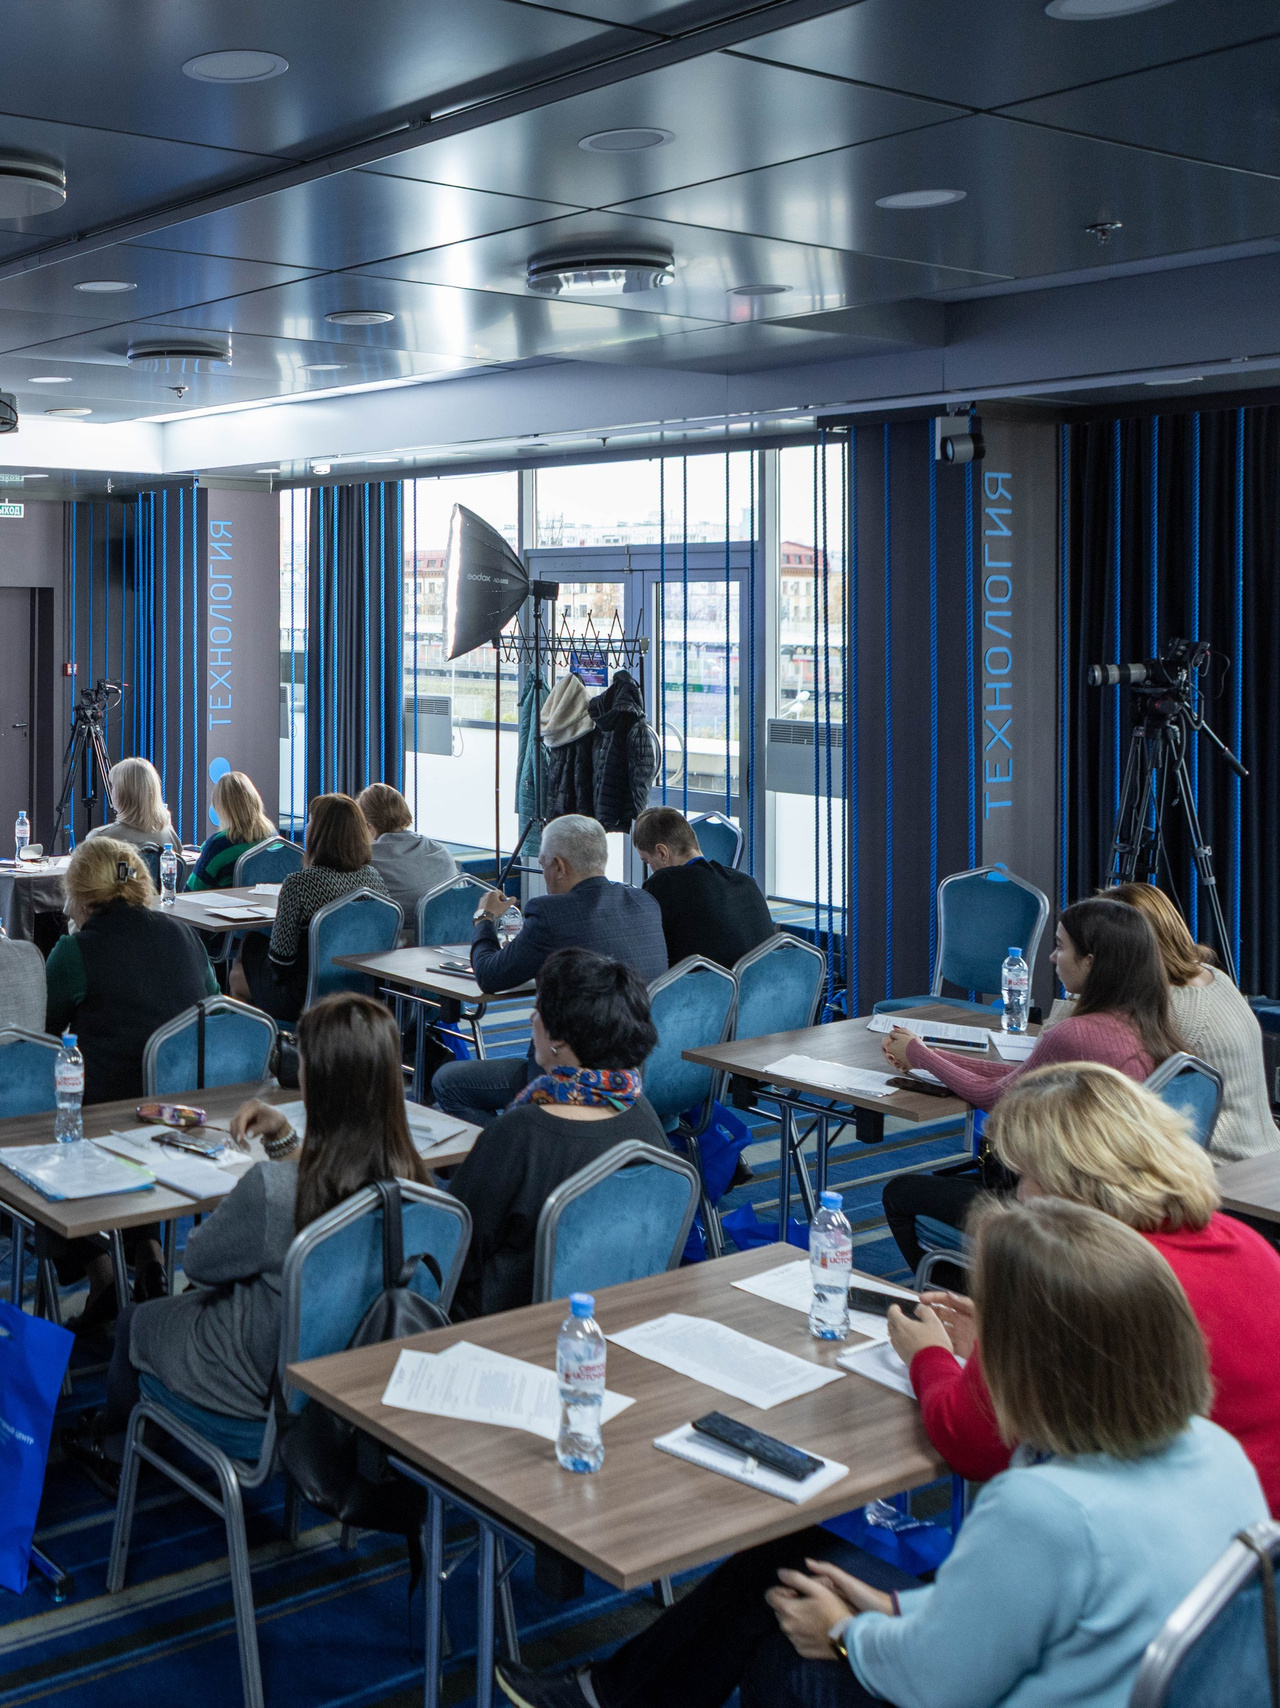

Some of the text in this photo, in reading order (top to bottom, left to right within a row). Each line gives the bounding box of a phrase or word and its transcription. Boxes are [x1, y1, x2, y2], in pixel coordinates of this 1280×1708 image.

[209, 520, 233, 731] ТЕХНОЛОГИЯ
[467, 573, 491, 582] Godox
[984, 471, 1013, 820] ТЕХНОЛОГИЯ
